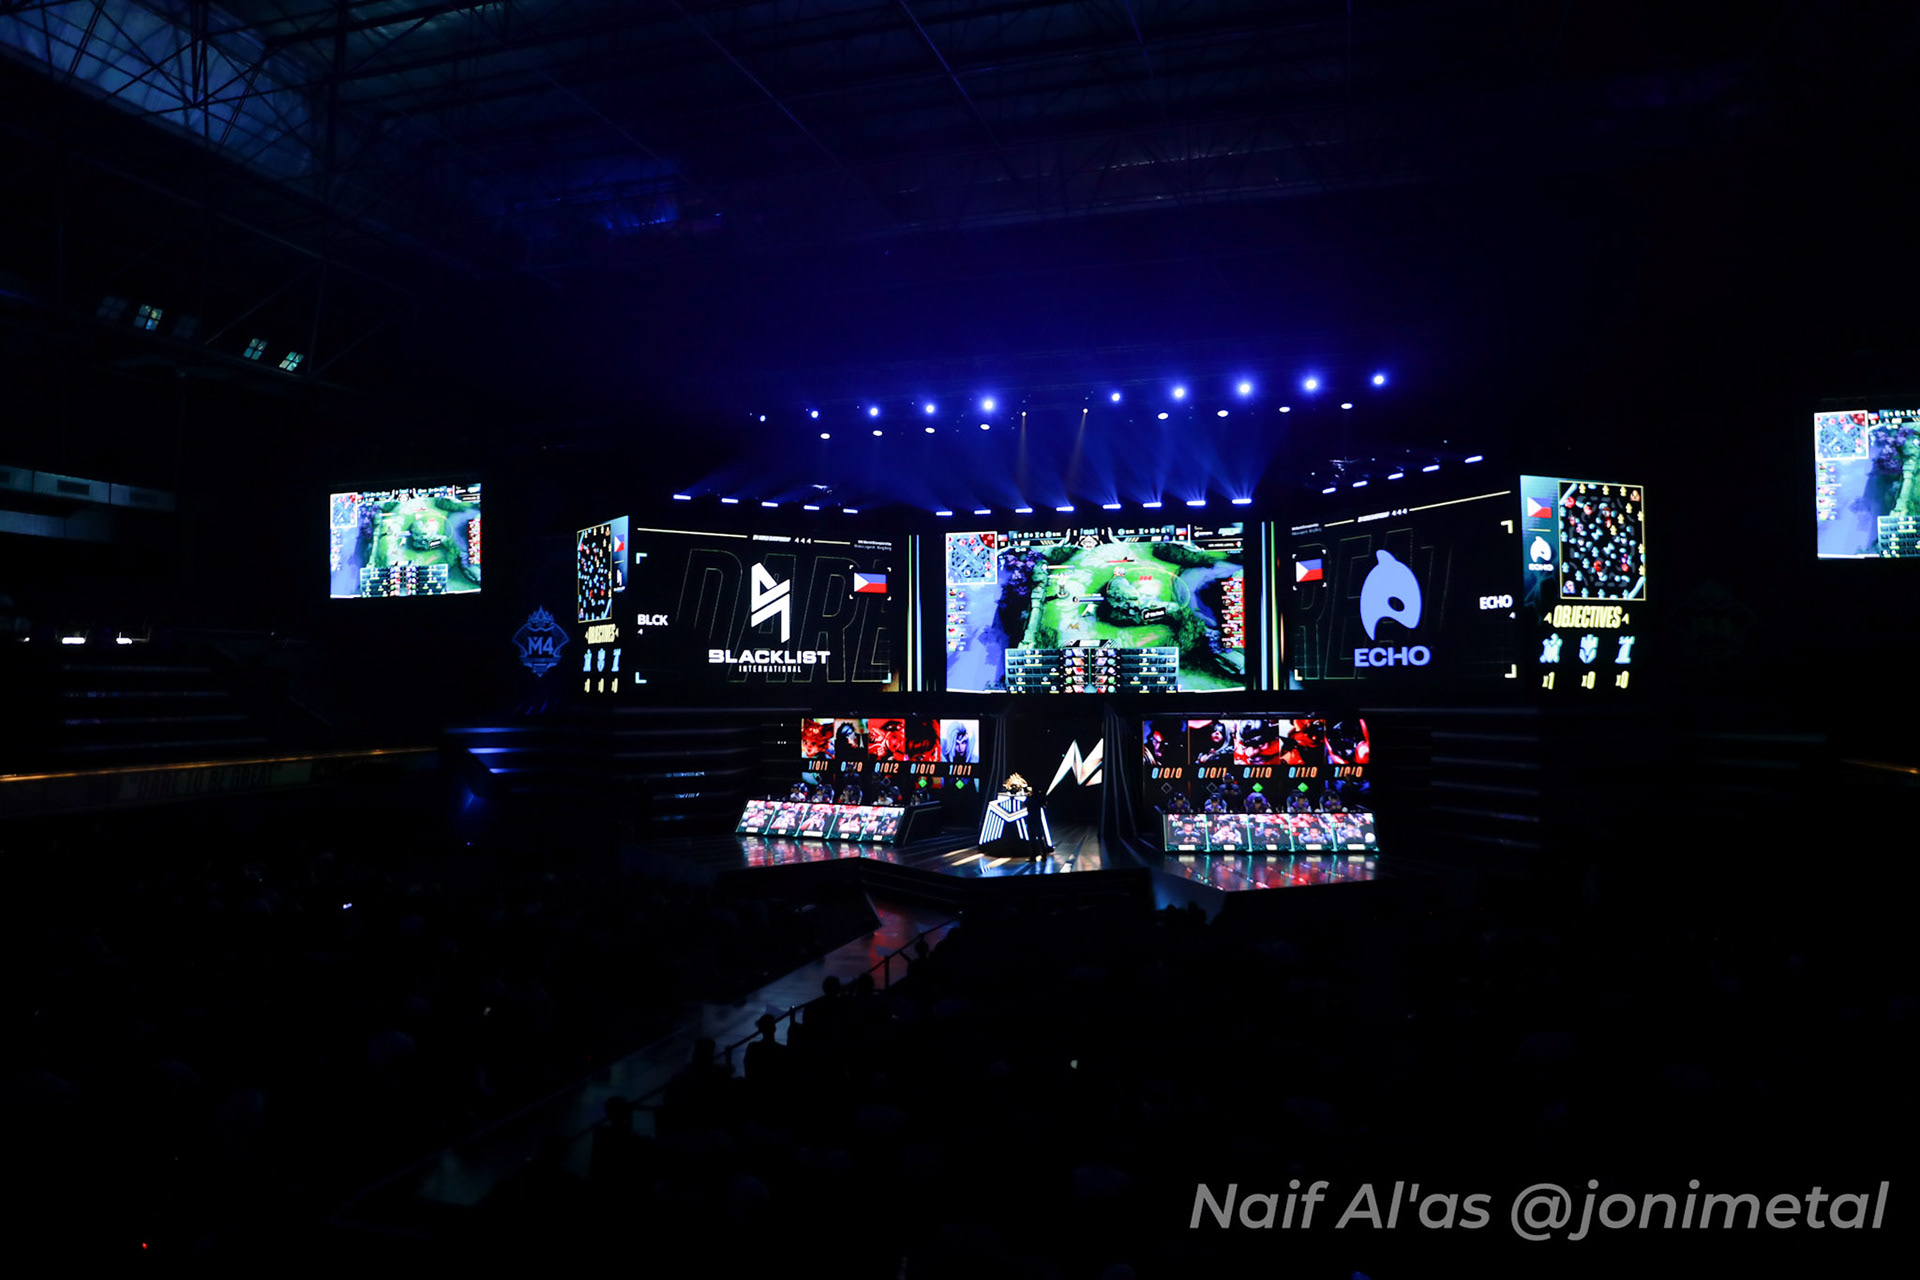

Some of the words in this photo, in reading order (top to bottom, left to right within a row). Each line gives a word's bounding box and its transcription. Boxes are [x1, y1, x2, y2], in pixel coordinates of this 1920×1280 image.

[1528, 562, 1554, 572] ECHO
[1479, 594, 1514, 611] ECHO
[637, 613, 669, 626] BLCK
[1552, 604, 1623, 629] OBJECTIVES
[527, 636, 554, 655] M4
[708, 649, 831, 665] BLACKLIST
[1354, 645, 1431, 668] ECHO
[738, 664, 802, 673] INTERNATIONAL
[808, 760, 828, 772] 1/0/1
[874, 762, 899, 774] 0/0/2
[910, 763, 936, 775] 0/0/0
[949, 764, 972, 776] 1/0/1
[1288, 766, 1318, 778] 0/1/0
[1151, 767, 1183, 779] 0/0/0
[1243, 766, 1272, 779] 0/1/0
